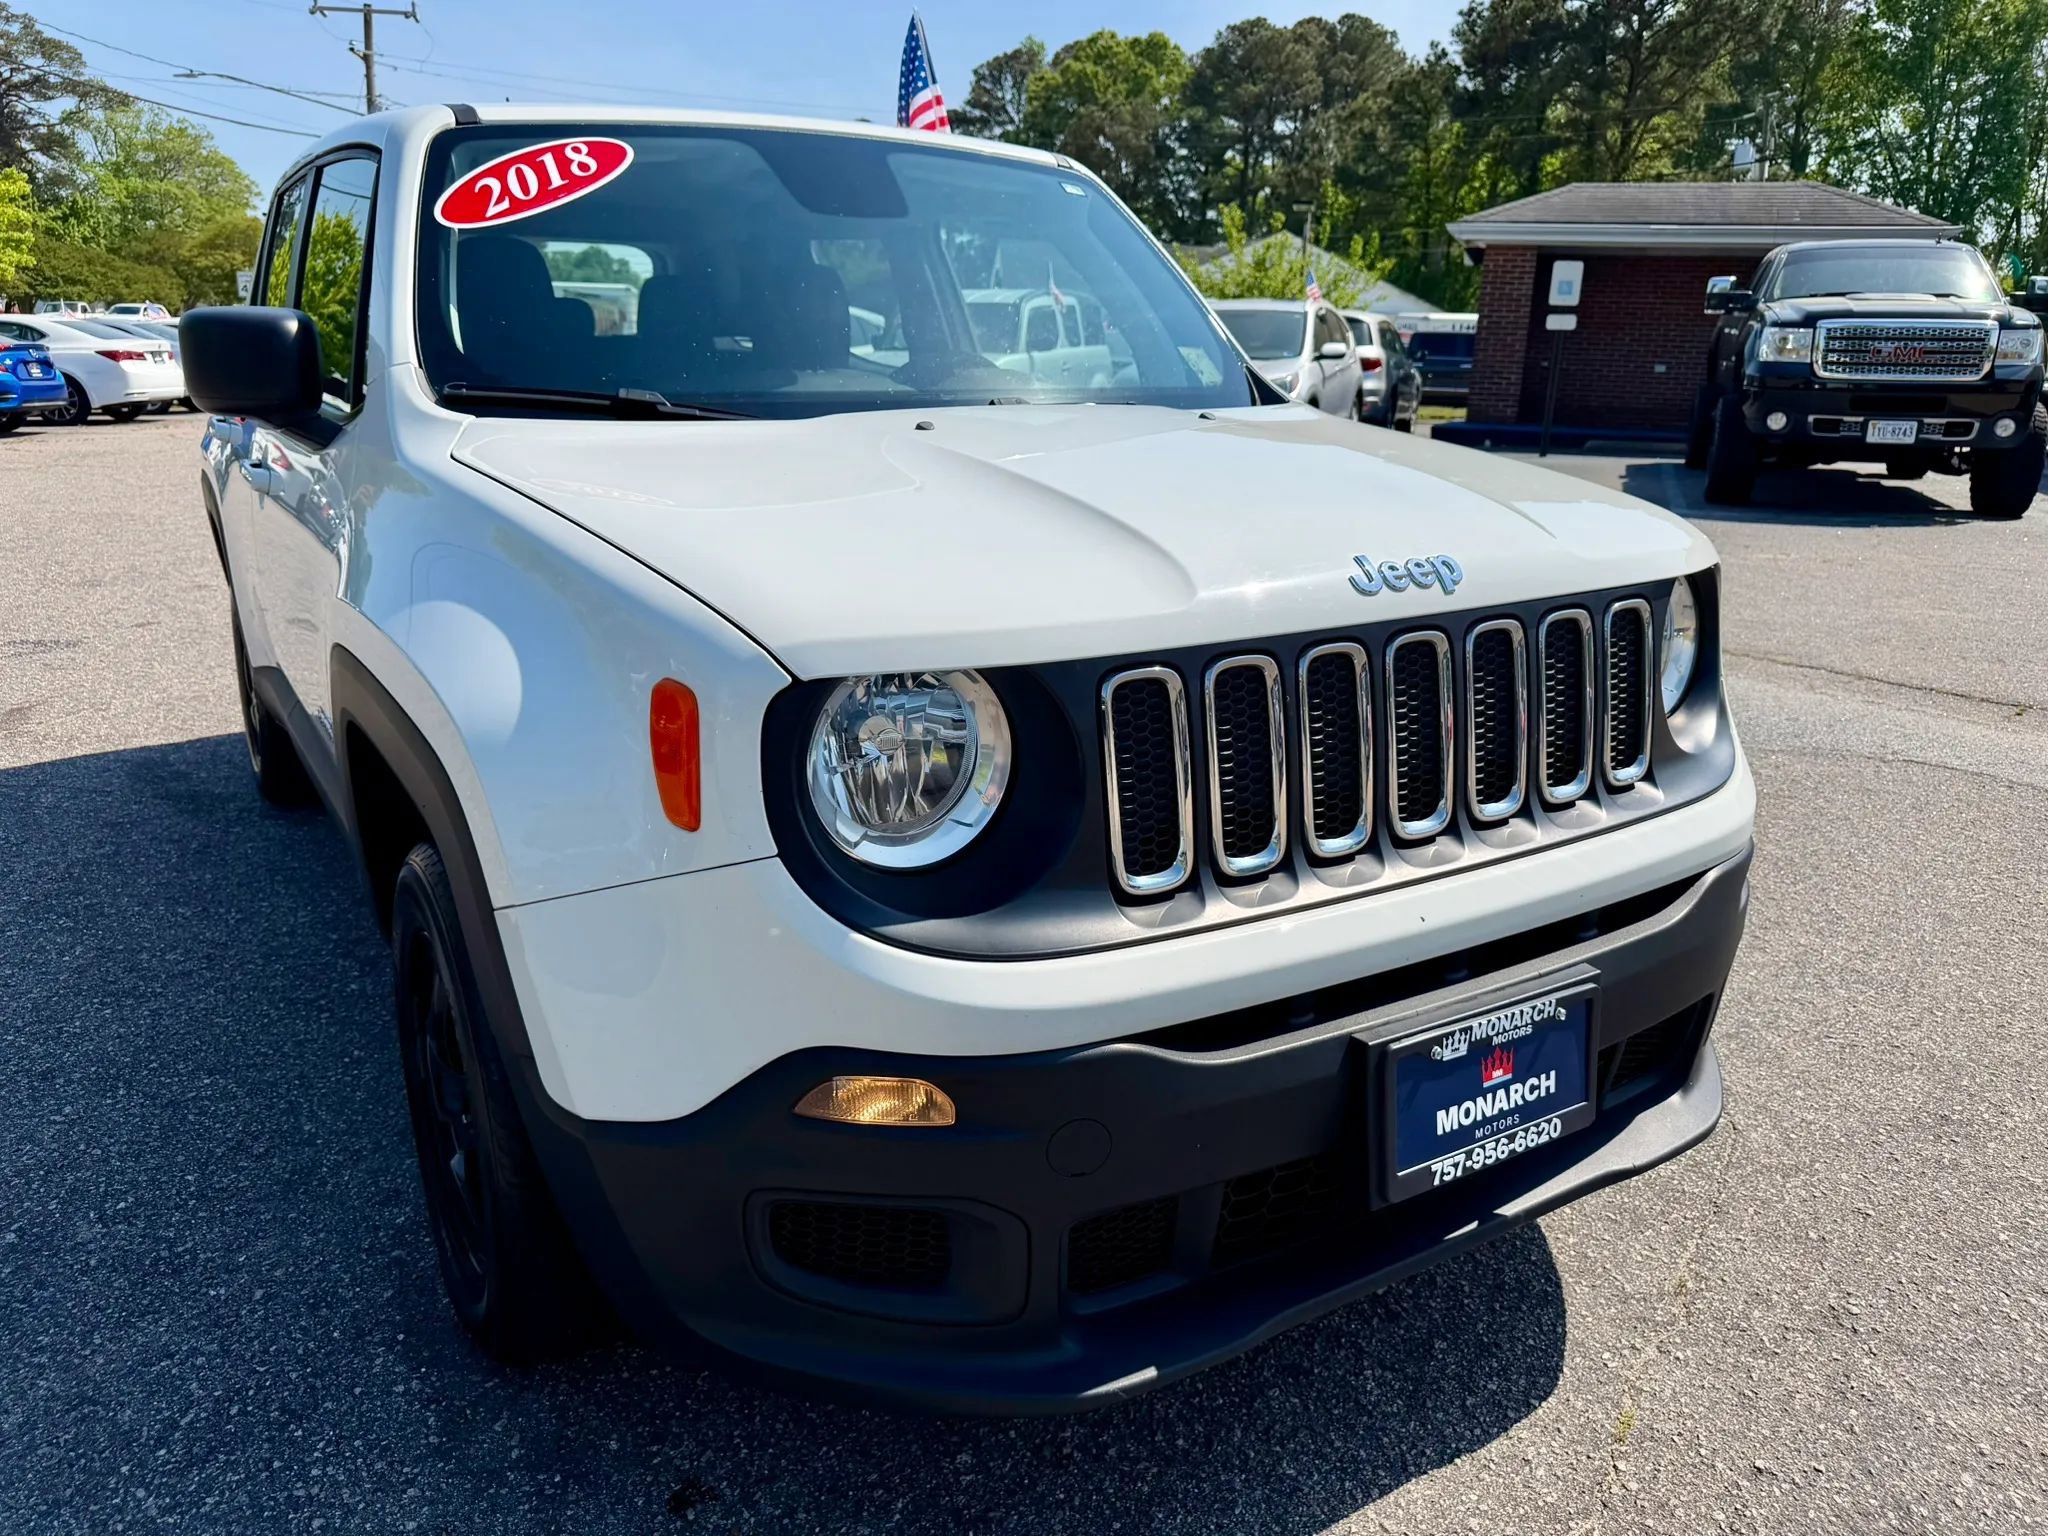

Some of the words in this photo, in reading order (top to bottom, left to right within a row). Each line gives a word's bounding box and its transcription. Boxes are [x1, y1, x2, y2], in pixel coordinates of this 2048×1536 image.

[474, 142, 598, 219] 2018
[1348, 554, 1463, 596] Jeep
[1471, 999, 1556, 1042] MONARCH
[1492, 1025, 1533, 1046] MOTORS
[1436, 1070, 1556, 1136] MONARCH
[1475, 1113, 1521, 1139] MOTORS
[1430, 1117, 1562, 1186] 757-956-6620
